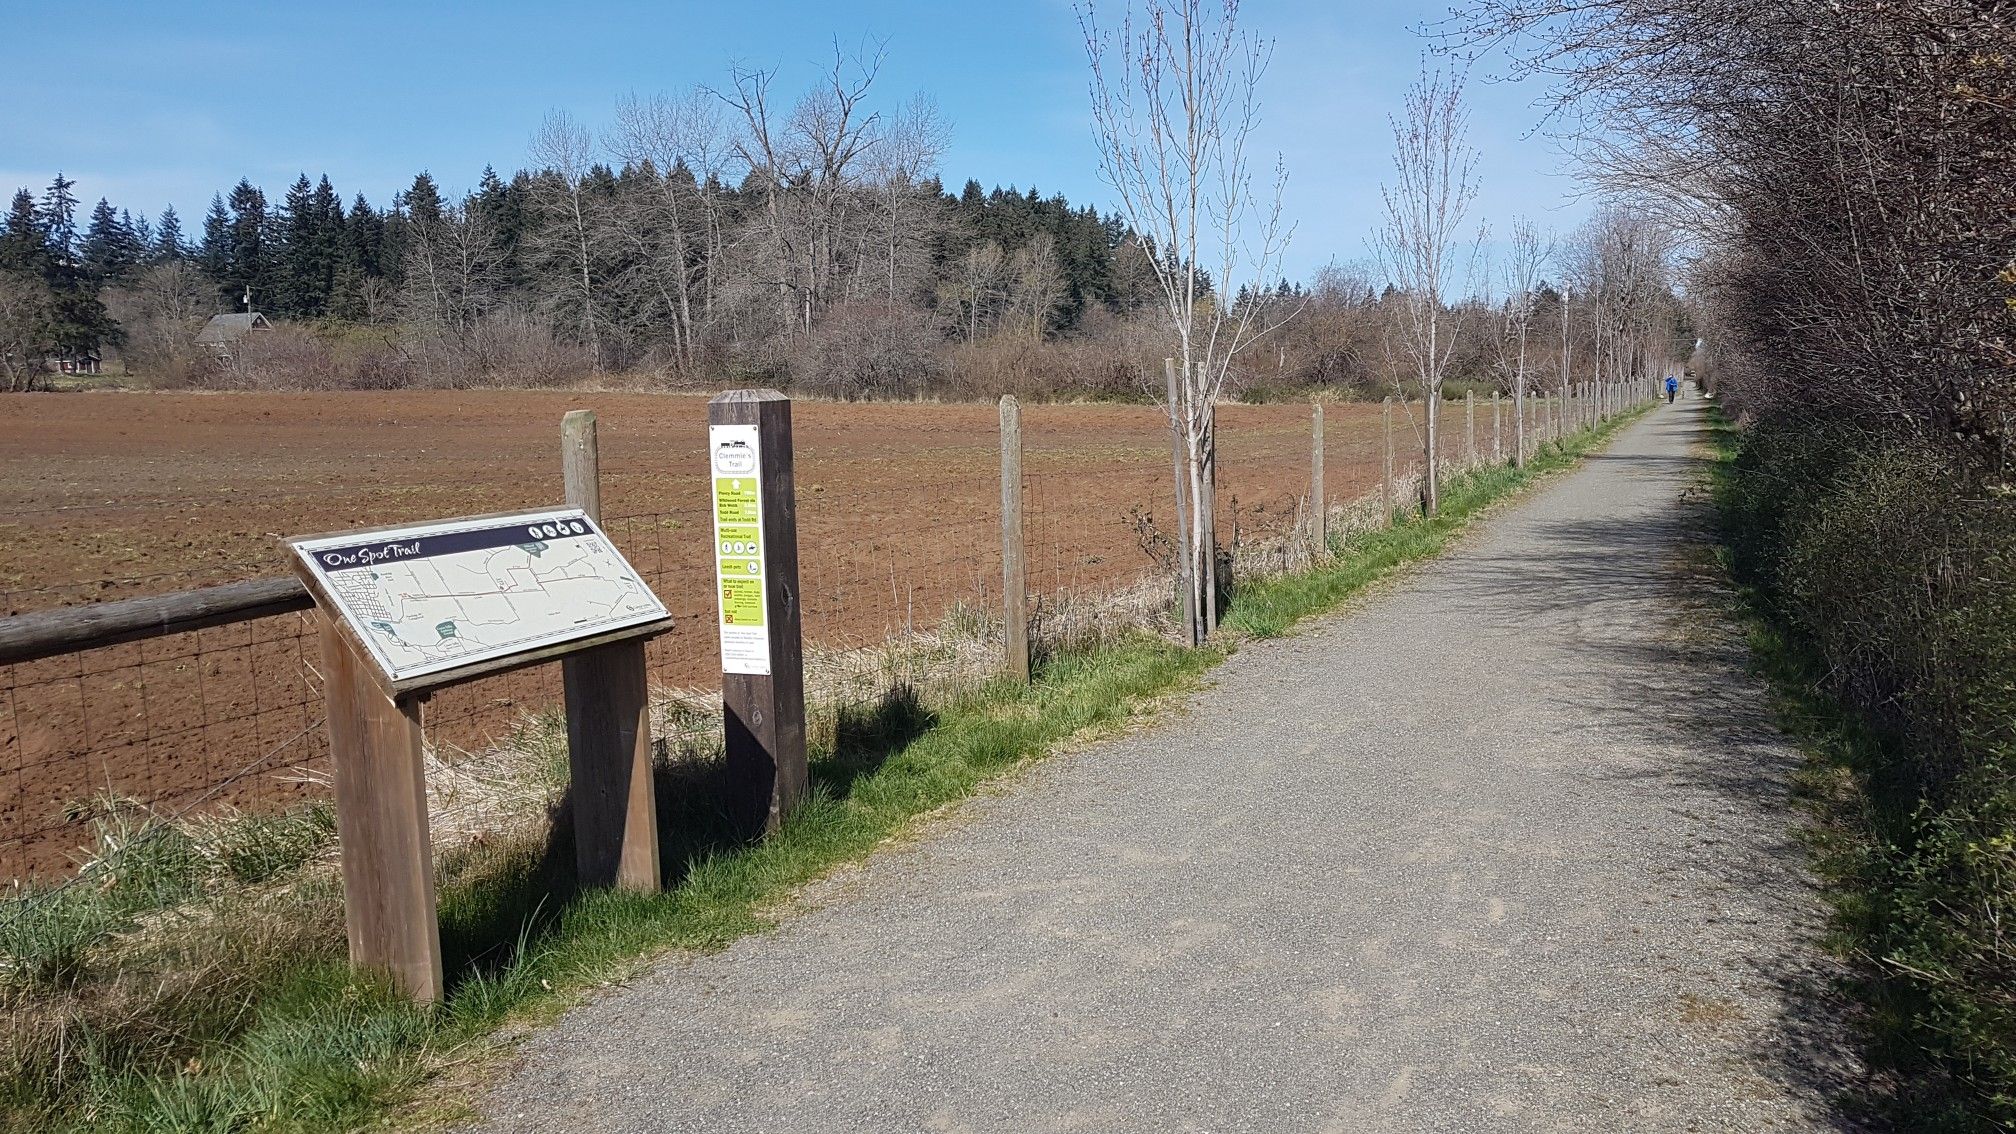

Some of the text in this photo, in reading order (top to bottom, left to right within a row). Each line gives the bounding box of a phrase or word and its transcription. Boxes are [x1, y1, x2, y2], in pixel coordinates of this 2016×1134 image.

[323, 542, 420, 565] One Spot Trail
